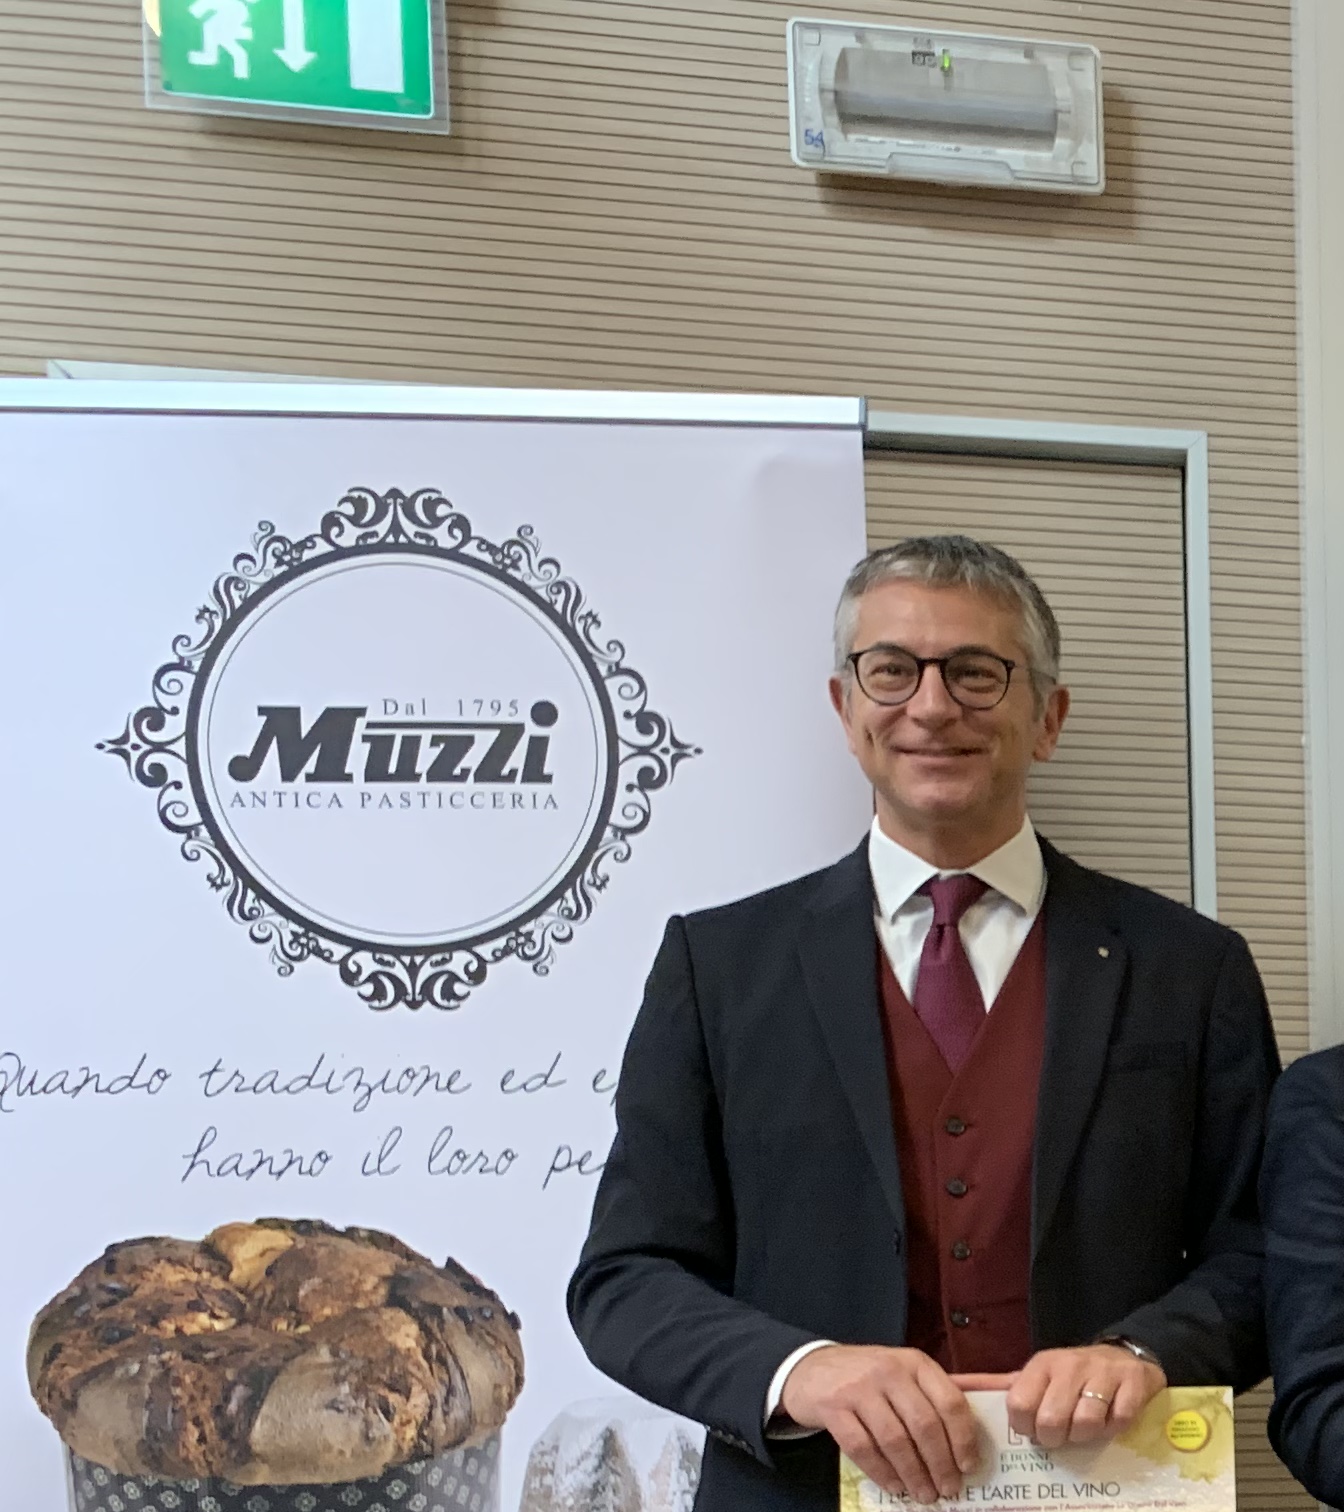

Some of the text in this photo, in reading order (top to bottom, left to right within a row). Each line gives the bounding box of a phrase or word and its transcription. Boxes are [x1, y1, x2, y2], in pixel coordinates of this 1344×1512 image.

[382, 698, 521, 718] Dal 1795
[227, 699, 560, 785] Muzzi
[229, 791, 560, 811] ANTICA PASTICCERIA
[0, 1051, 617, 1112] Quando tradizione ed e
[181, 1126, 333, 1184] hanno
[361, 1126, 403, 1178] il
[429, 1126, 519, 1178] loro
[967, 1485, 976, 1501] E
[982, 1483, 1032, 1501] L'ARTE
[1038, 1483, 1068, 1499] DEL
[1073, 1481, 1121, 1498] VINO
